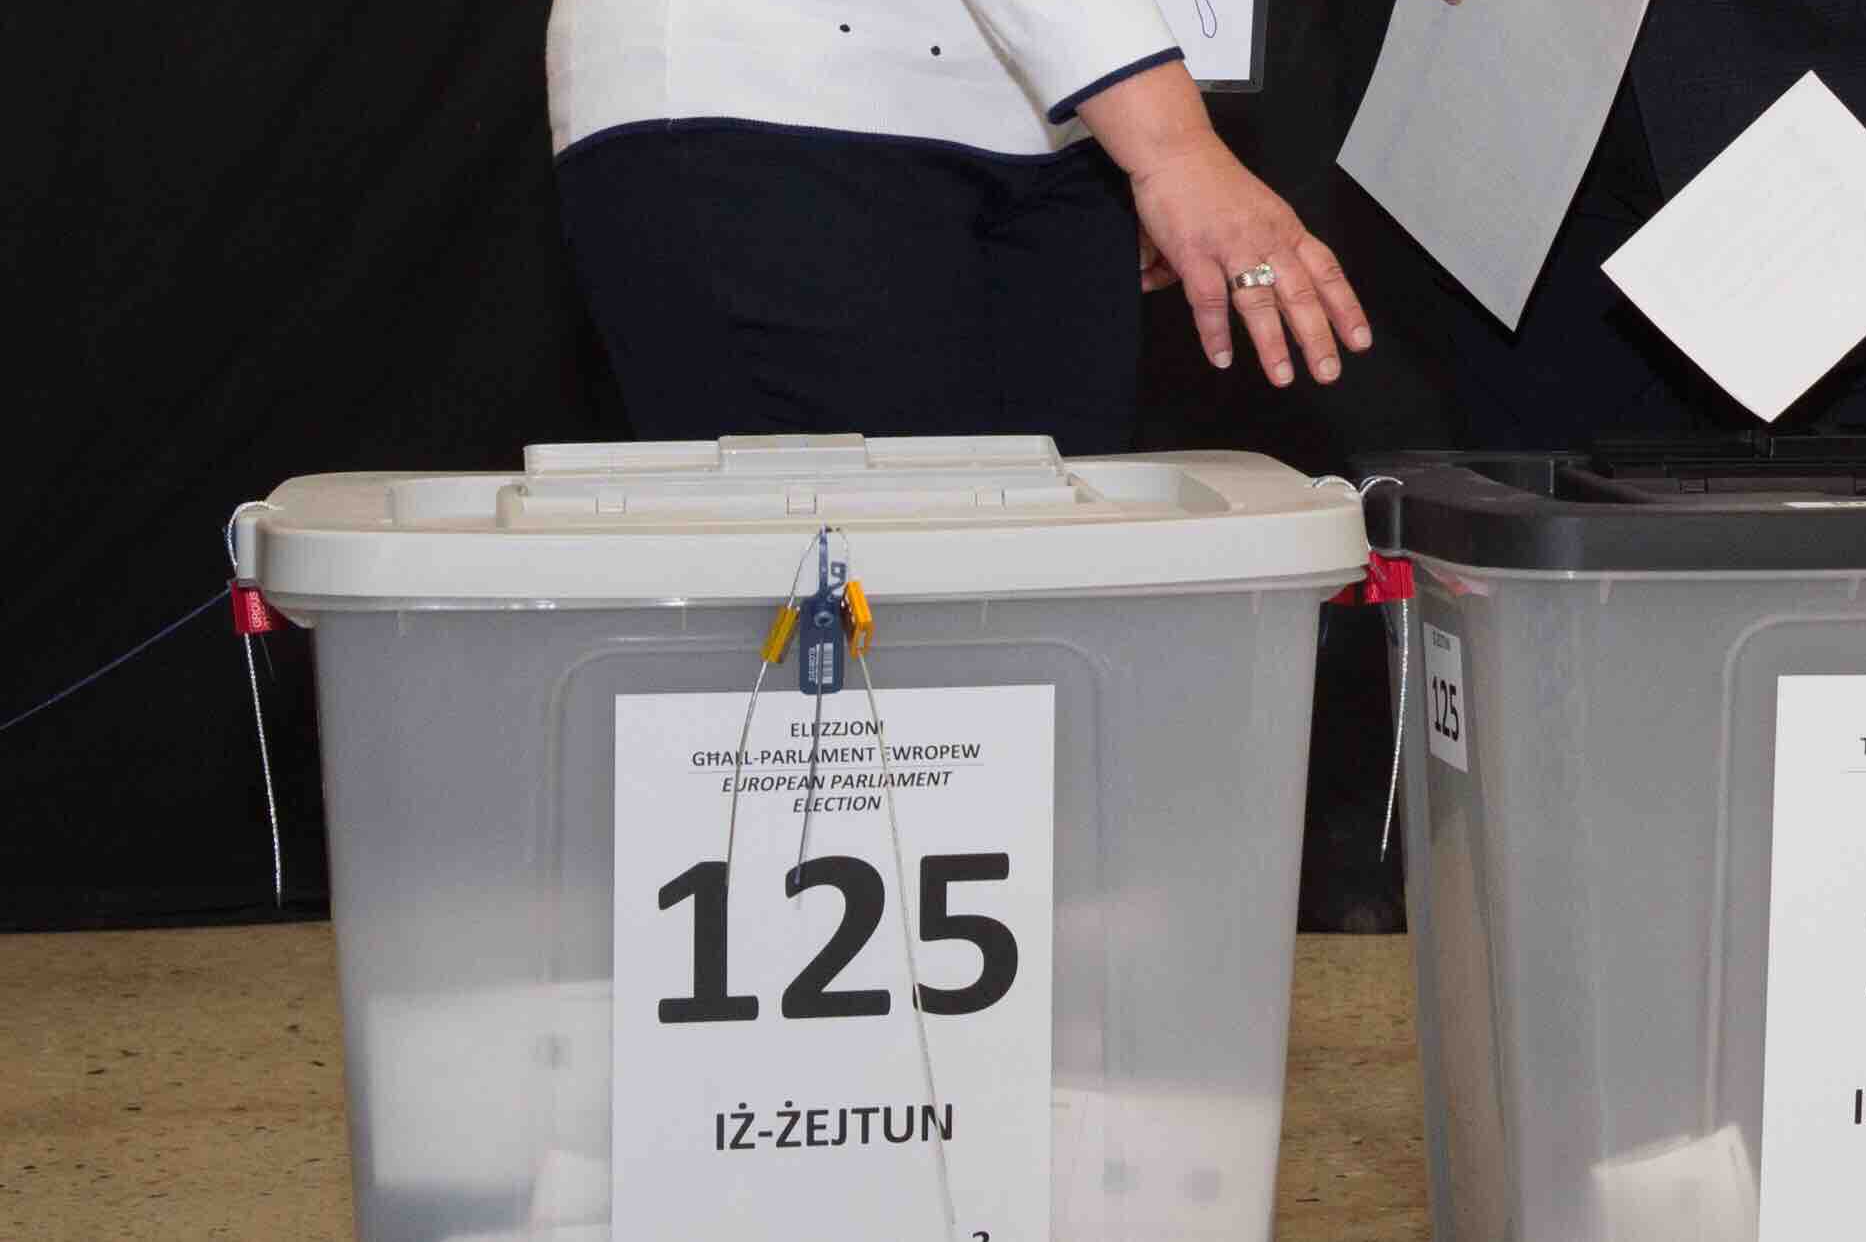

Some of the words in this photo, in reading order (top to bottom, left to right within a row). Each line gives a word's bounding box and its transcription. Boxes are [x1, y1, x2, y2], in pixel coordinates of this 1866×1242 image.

[1432, 675, 1459, 742] 125
[722, 774, 825, 793] EUROPEAN
[830, 771, 953, 790] PARLIAMENT
[793, 795, 882, 814] ELECTION
[658, 852, 1019, 1024] 125
[716, 1100, 953, 1151] IŻ-ŻEJTUN
